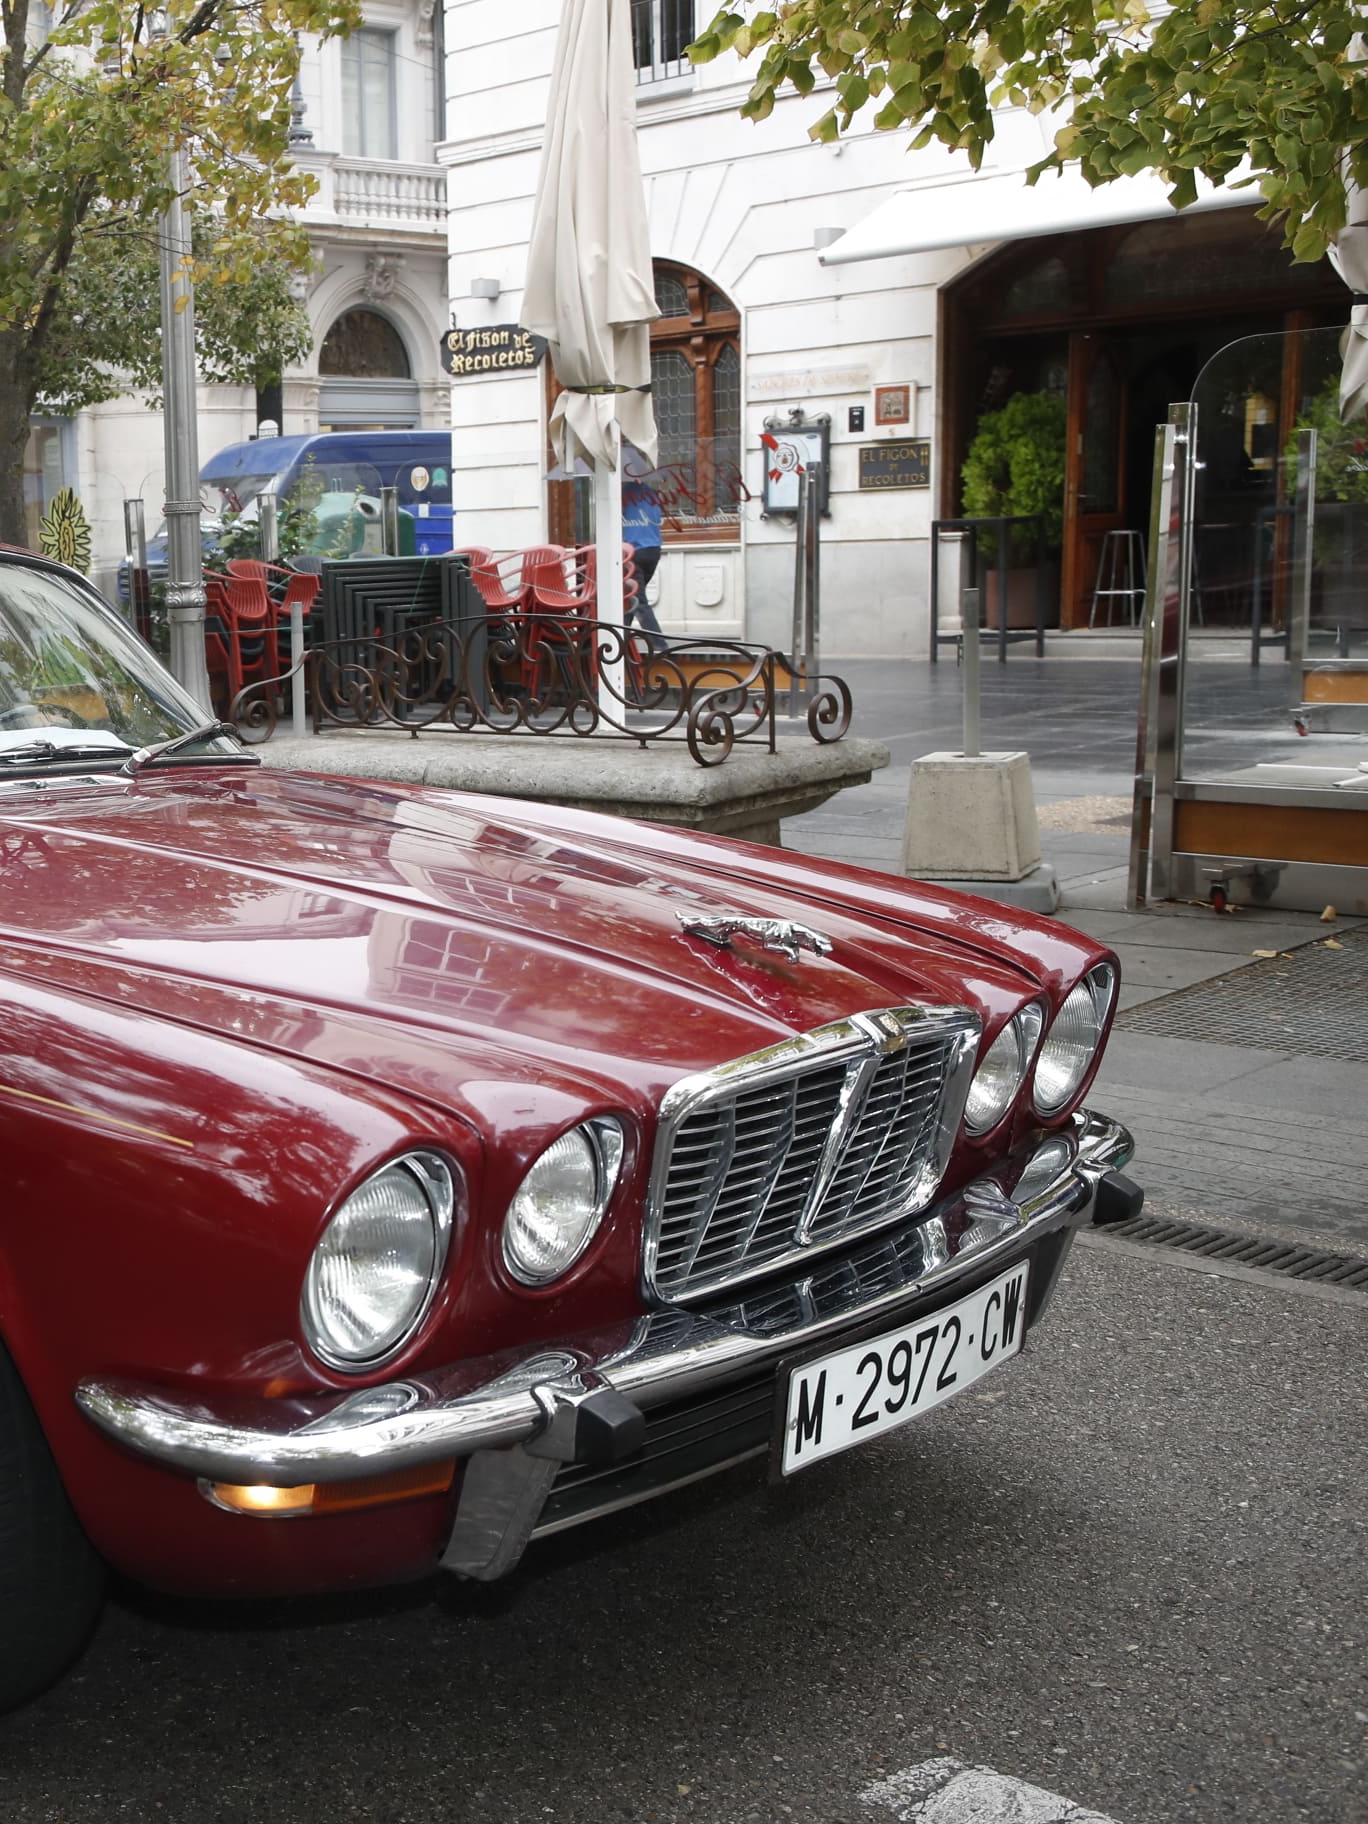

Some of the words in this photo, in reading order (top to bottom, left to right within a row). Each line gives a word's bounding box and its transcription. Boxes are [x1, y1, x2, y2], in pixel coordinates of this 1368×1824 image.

[450, 346, 536, 373] Recoletos
[862, 450, 875, 462] EL
[862, 472, 926, 486] RECOLETOS
